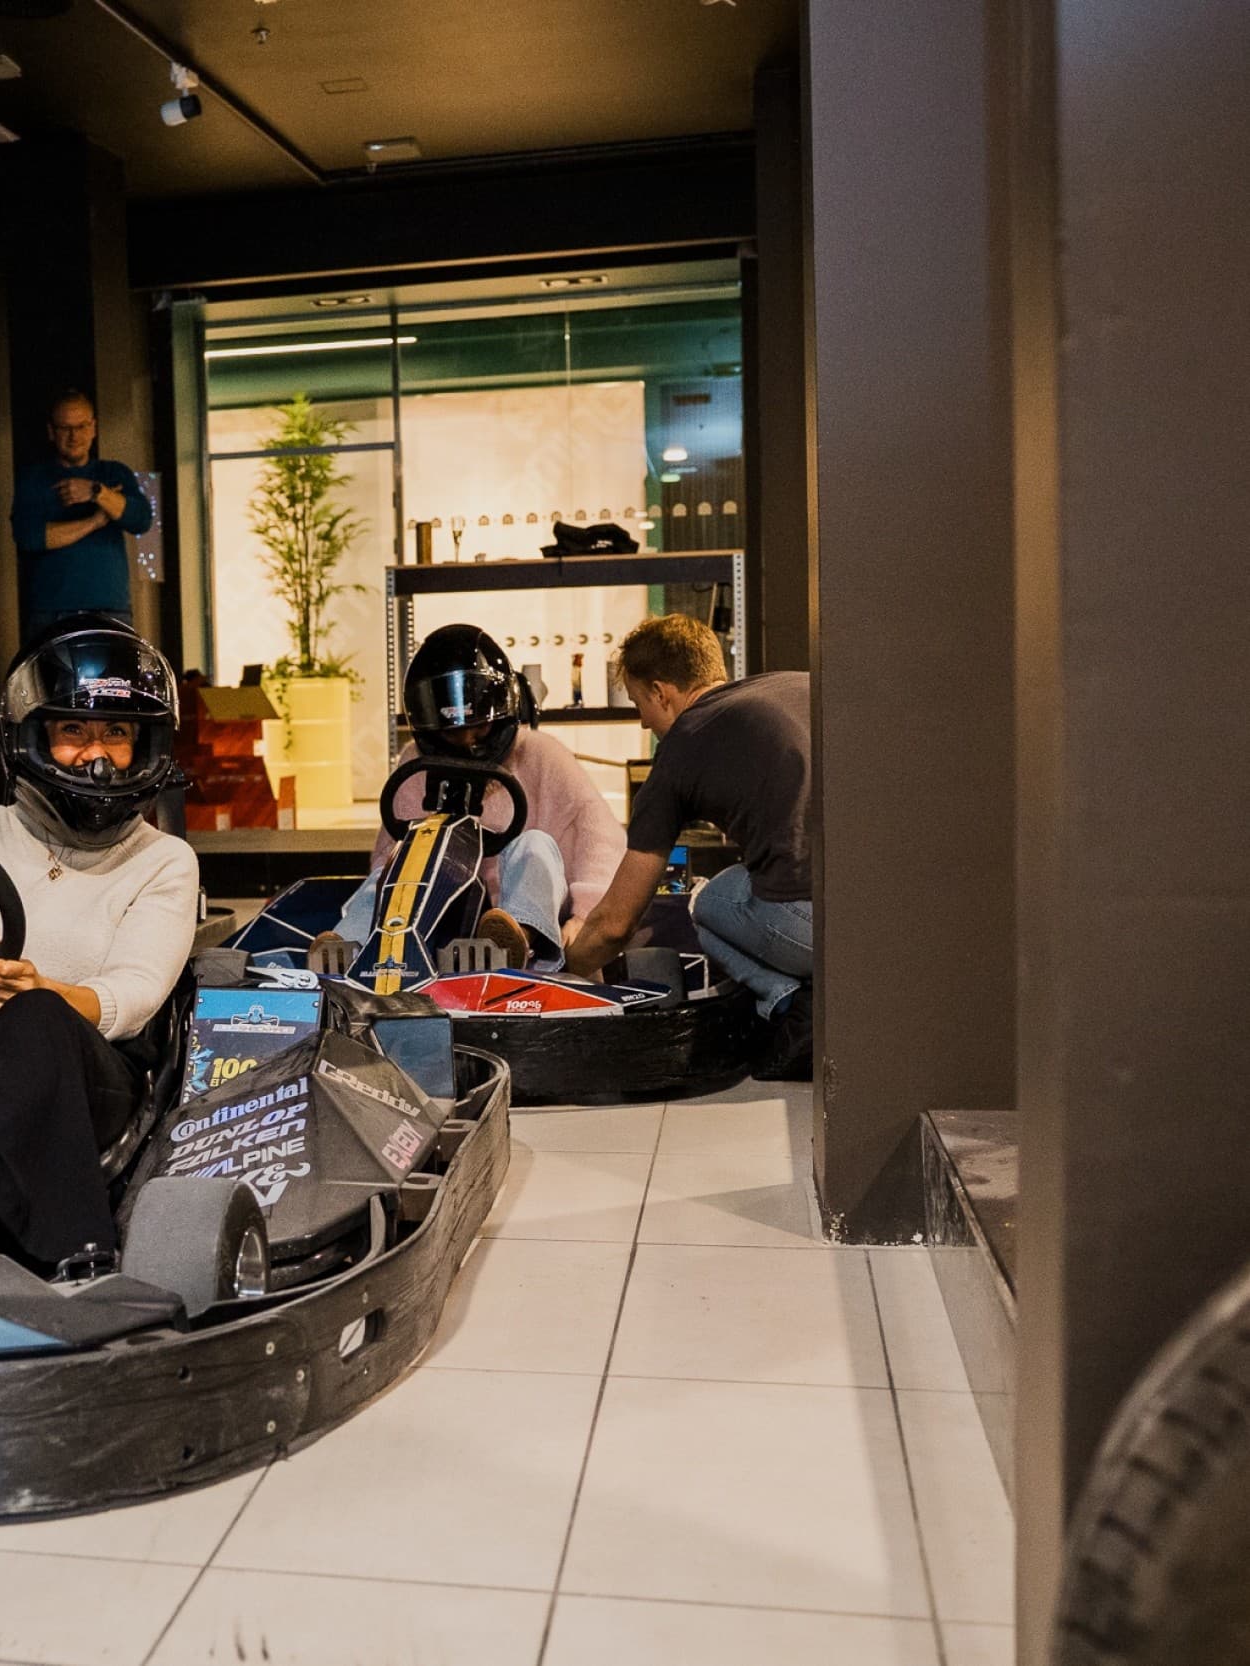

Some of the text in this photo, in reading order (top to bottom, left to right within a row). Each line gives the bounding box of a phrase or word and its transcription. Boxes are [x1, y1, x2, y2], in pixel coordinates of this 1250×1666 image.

[507, 1000, 542, 1009] 100%
[167, 1102, 308, 1161] DUNLOP
[170, 1077, 309, 1142] Continental
